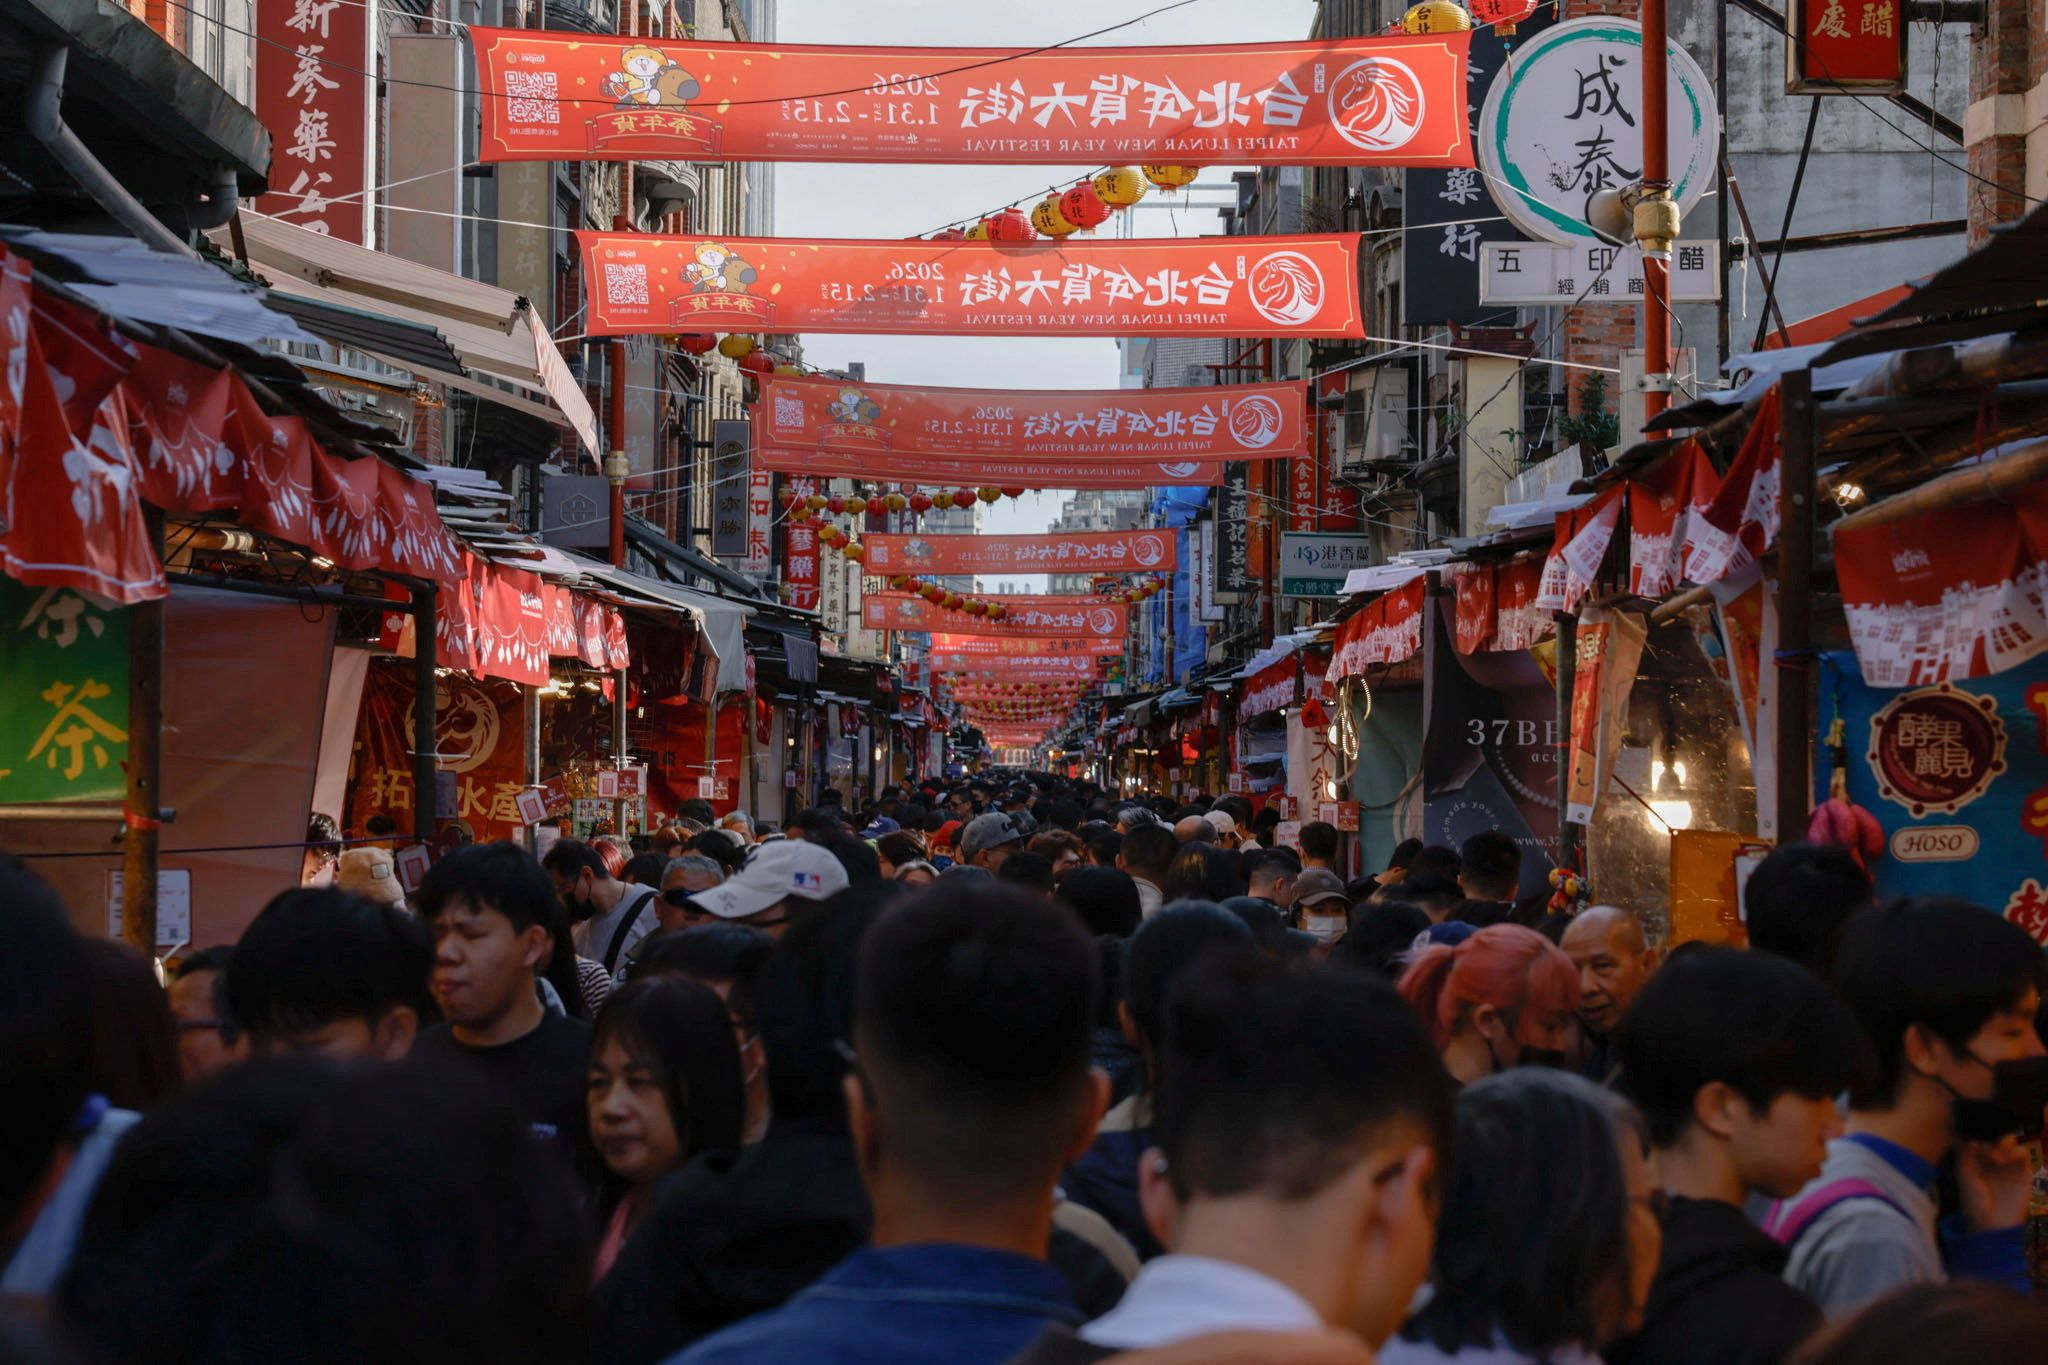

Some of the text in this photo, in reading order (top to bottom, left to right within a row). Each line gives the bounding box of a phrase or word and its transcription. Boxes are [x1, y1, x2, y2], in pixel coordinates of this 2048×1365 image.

[1860, 0, 1894, 39] 醋
[1563, 53, 1643, 194] 成泰
[1105, 174, 1118, 195] 台北
[1039, 203, 1055, 228] 台北
[1070, 192, 1085, 219] 台北
[1498, 246, 1705, 274] 五印醋
[1557, 277, 1644, 295] 經銷商
[27, 678, 129, 781] 茶
[371, 765, 527, 824] 拓水產
